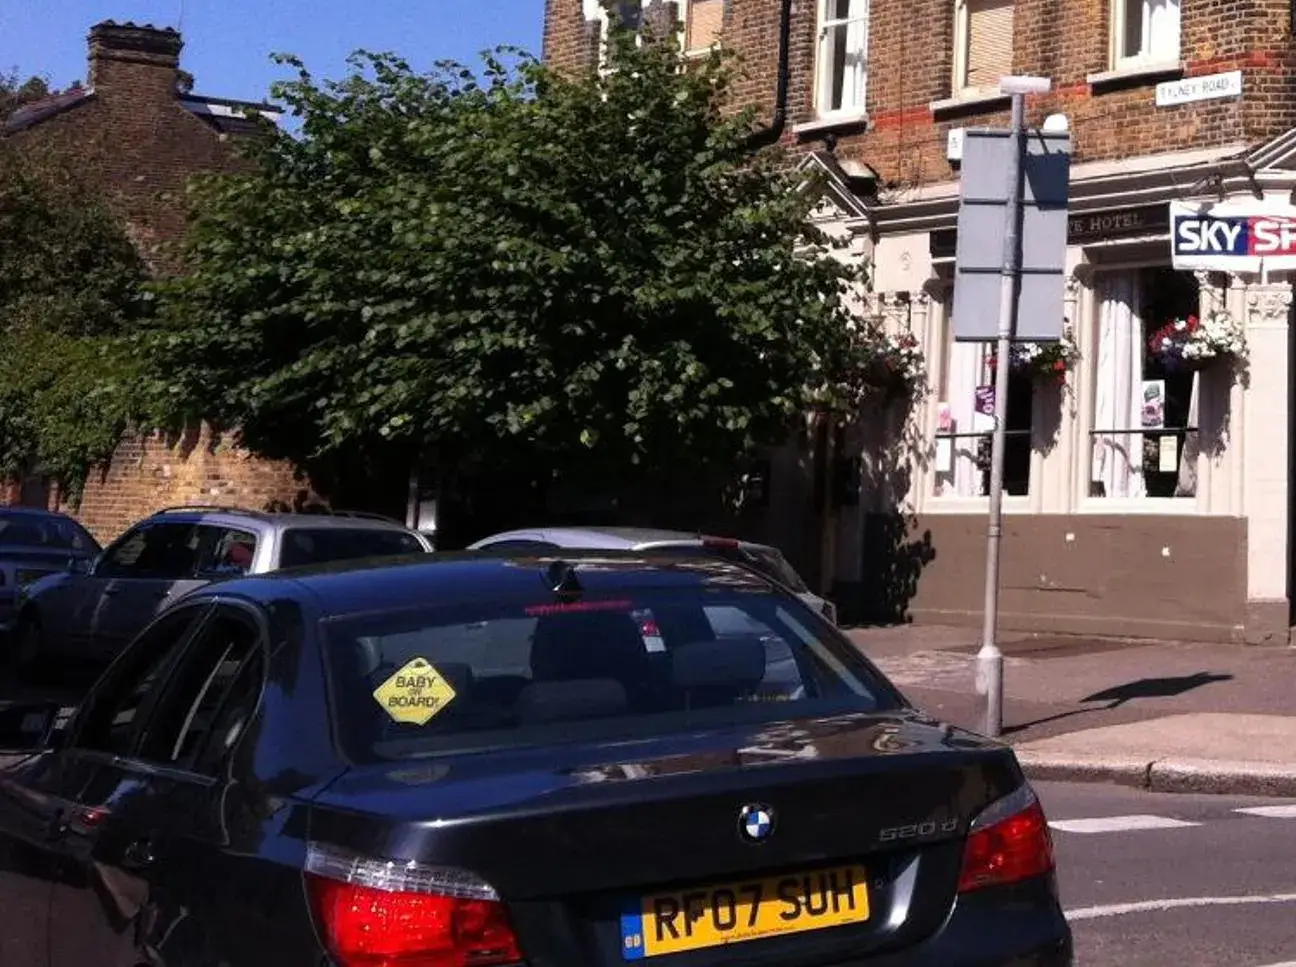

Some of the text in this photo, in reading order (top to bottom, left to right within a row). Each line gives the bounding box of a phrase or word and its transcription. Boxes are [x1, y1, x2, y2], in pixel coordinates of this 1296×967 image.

[1202, 76, 1230, 93] ROAD
[1090, 212, 1144, 231] HOTEL
[1178, 220, 1242, 252] SKY
[395, 675, 437, 688] BABY
[652, 869, 857, 942] RF07 SUH
